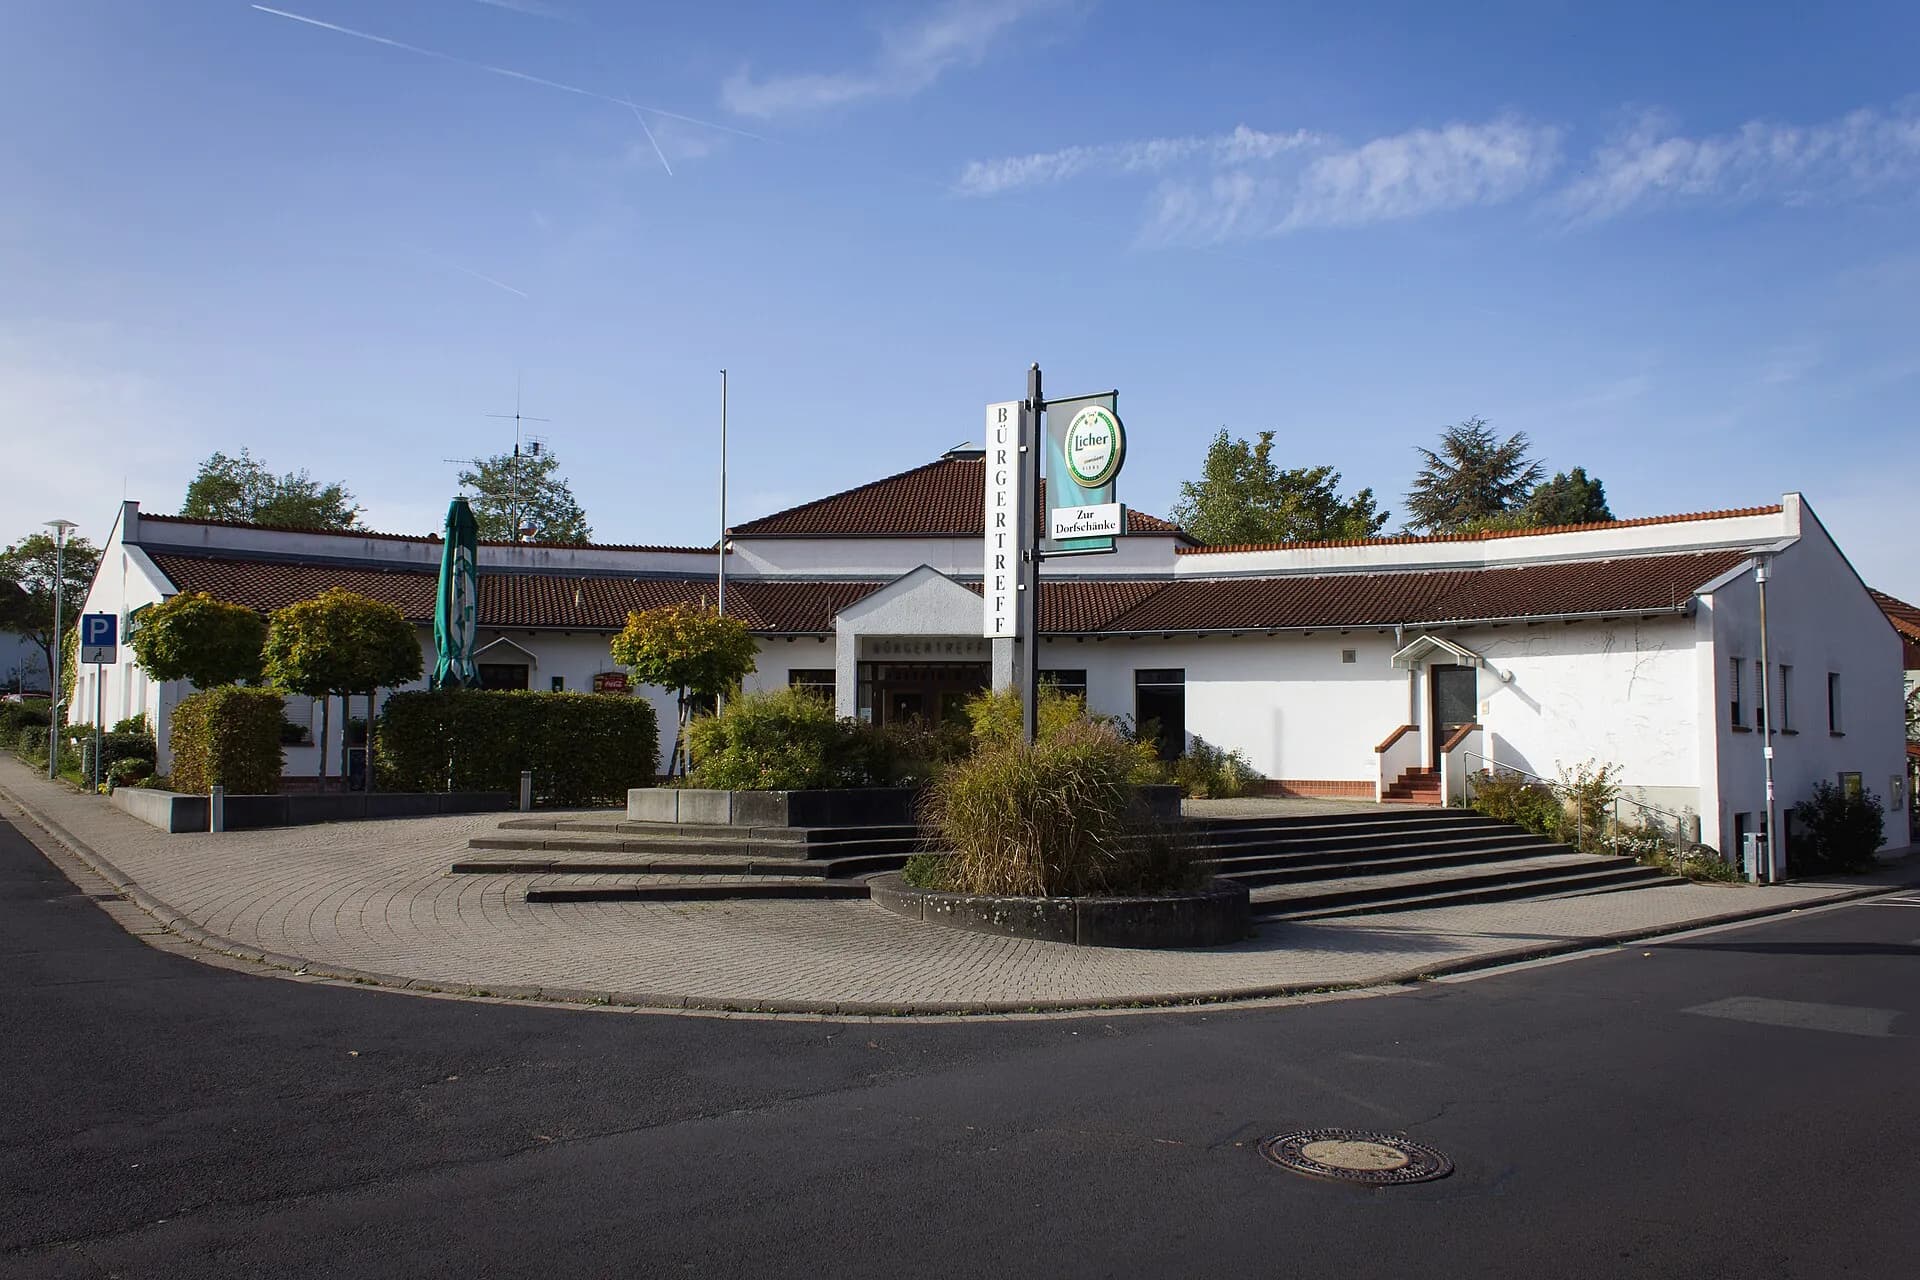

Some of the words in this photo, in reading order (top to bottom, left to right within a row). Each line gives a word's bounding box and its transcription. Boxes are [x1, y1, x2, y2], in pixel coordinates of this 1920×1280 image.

[1075, 433, 1109, 451] Licher
[995, 407, 1008, 633] BÜRGERTREFF
[1077, 510, 1094, 520] Zur
[1056, 520, 1116, 534] Dorfschänke
[90, 618, 109, 643] P
